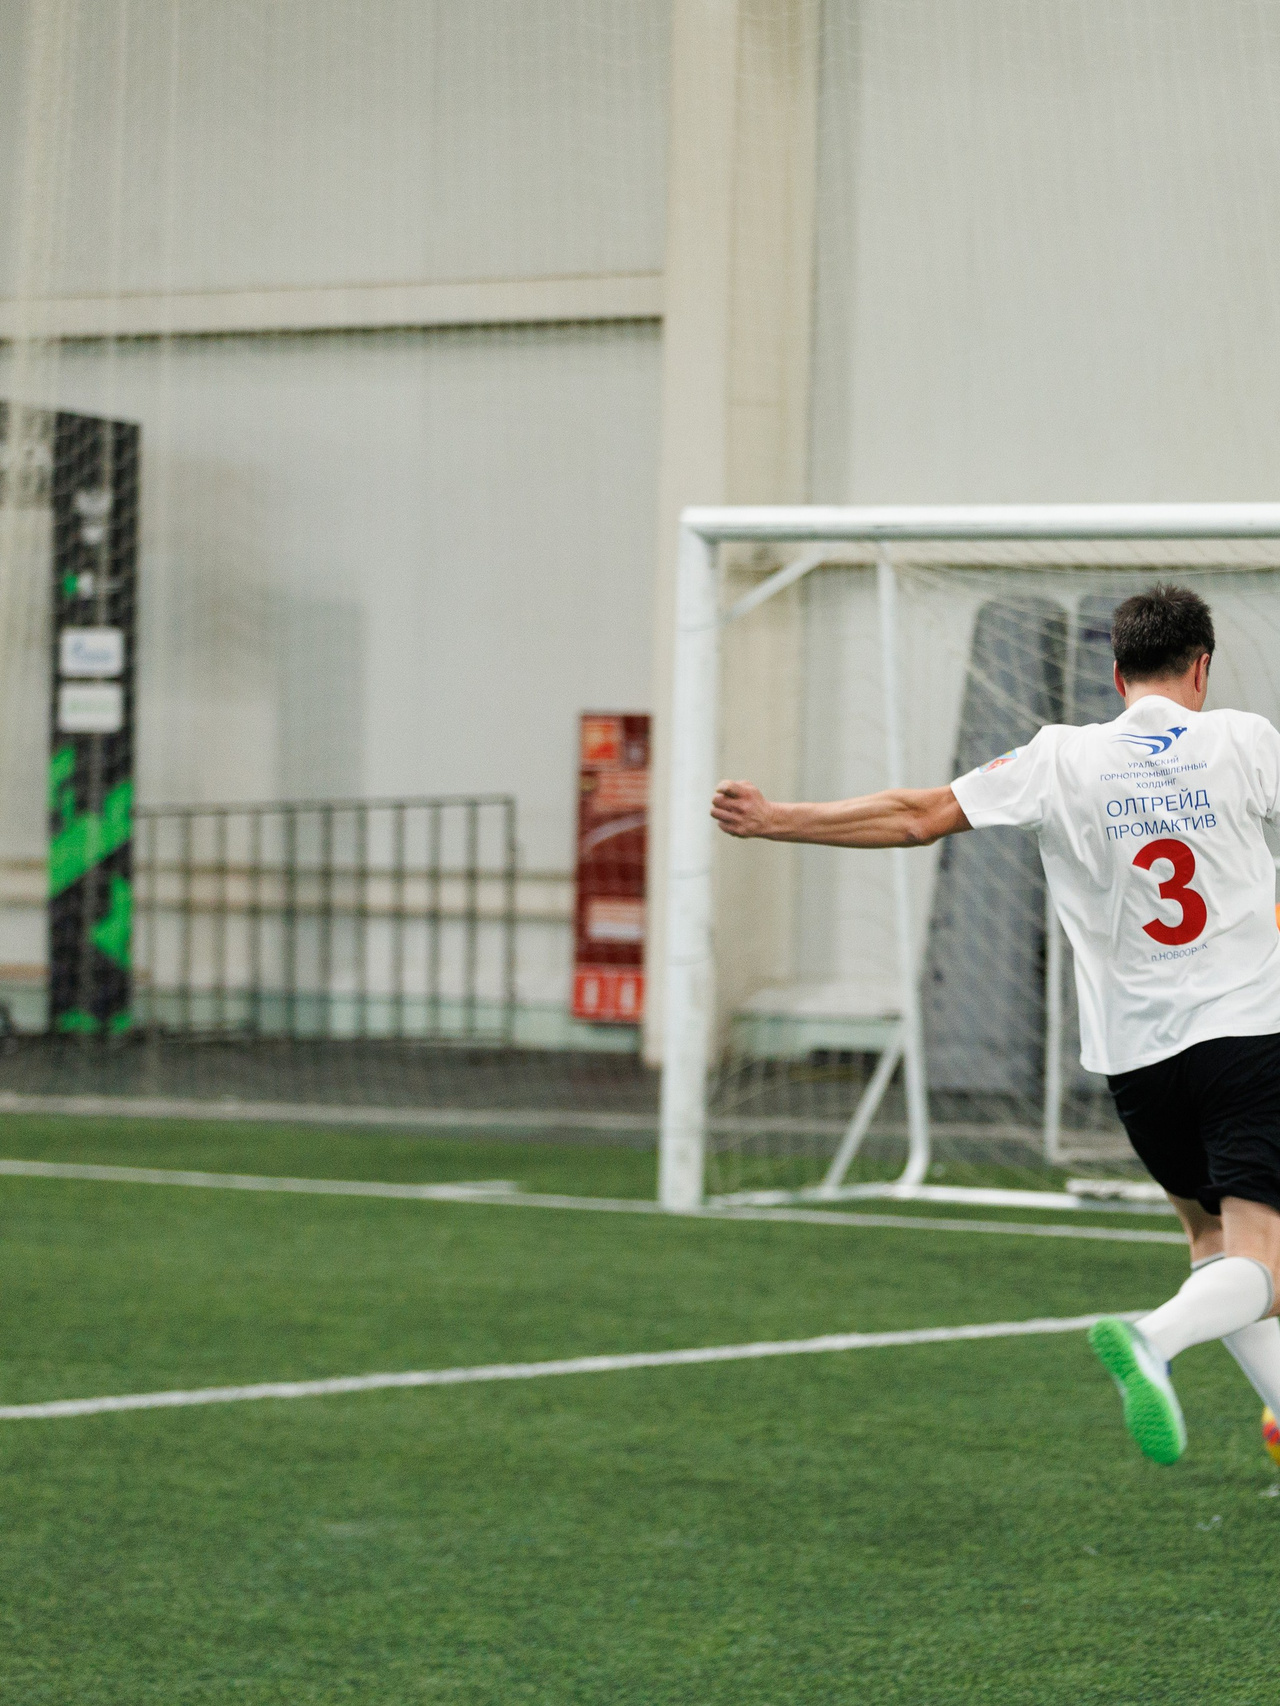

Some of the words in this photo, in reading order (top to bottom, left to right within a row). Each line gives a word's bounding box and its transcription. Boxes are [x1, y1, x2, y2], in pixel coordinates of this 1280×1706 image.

[1100, 761, 1208, 781] ГОРНОПРОМЫШЛЕННЫЙ
[1127, 755, 1179, 768] УРАЛЬСКИЙ
[1136, 778, 1176, 789] ХОЛДИНГ
[1106, 788, 1210, 817] ОЛТРЕЙД
[1106, 814, 1217, 841] ПРОМАКТИВ
[1132, 838, 1207, 946] 3
